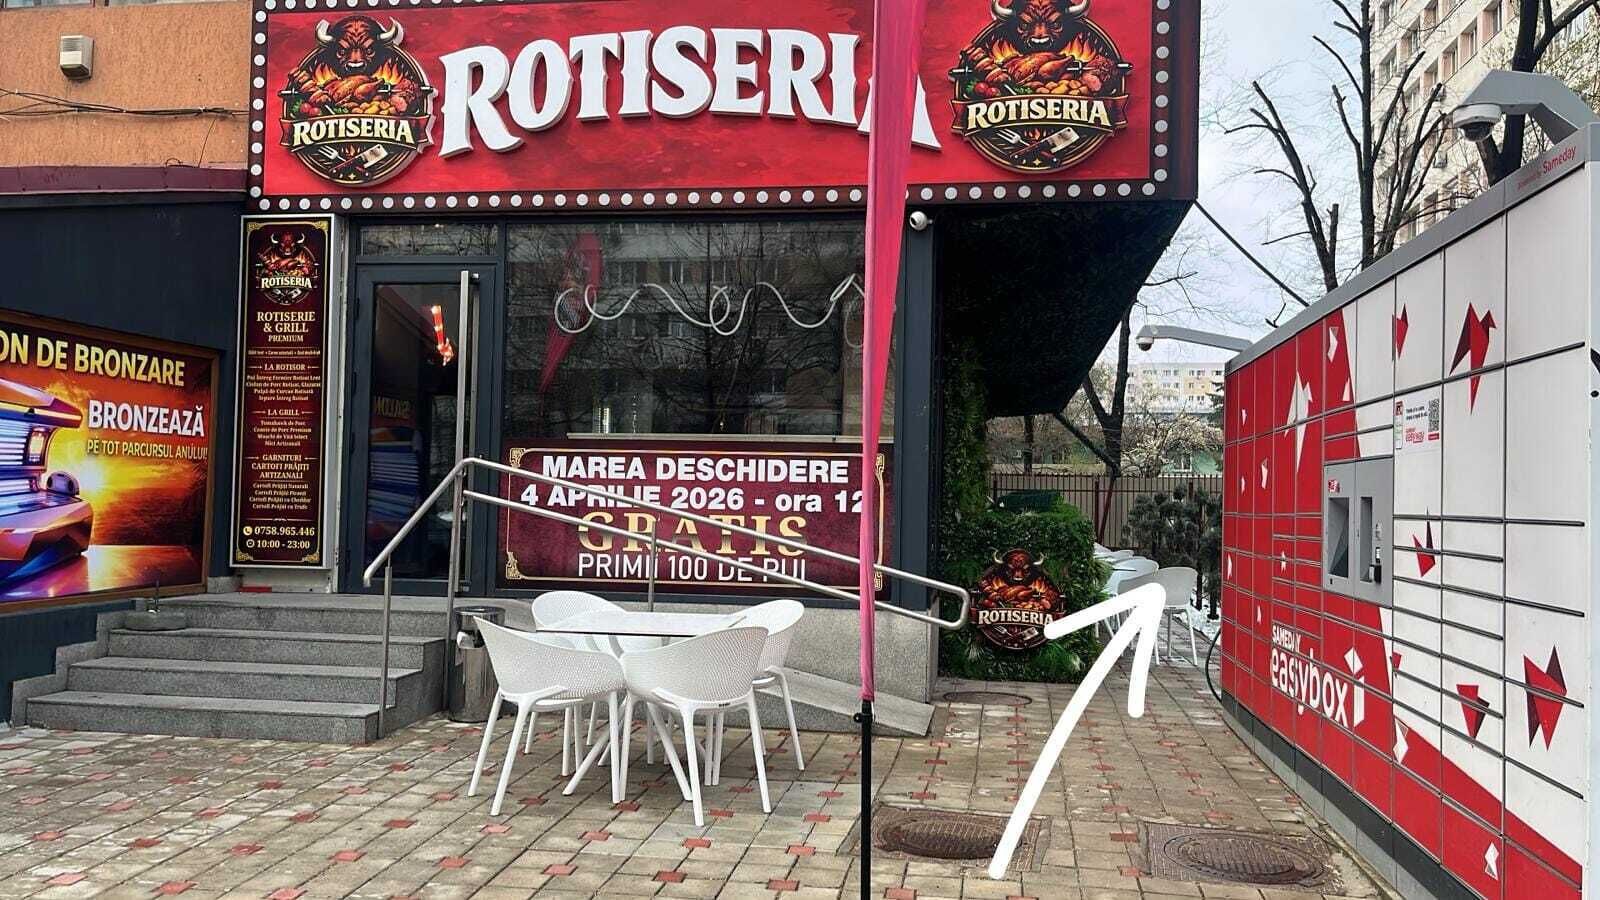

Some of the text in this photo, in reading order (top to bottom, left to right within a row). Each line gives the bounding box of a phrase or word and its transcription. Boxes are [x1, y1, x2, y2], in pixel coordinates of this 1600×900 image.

[966, 97, 1112, 131] ROTISERIA
[293, 117, 415, 147] ROTISERIA
[1542, 145, 1577, 174] Sameday
[260, 276, 313, 289] ROTISERIA
[256, 311, 316, 322] ROTISERIE
[263, 322, 309, 333] & GRILL
[268, 334, 304, 342] PREMIUM
[37, 336, 69, 371] DE
[75, 343, 185, 387] BRONZARE
[264, 363, 306, 371] LA ROTISOR
[88, 399, 205, 437] BRONZEAZĂ
[87, 438, 100, 454] PE
[101, 440, 120, 455] TOT
[121, 440, 174, 459] PARCURSUL
[262, 454, 302, 462] GARNITURI
[260, 471, 303, 479] ARTIZANALI
[542, 455, 849, 484] MAREA DESCHIDERE
[520, 484, 539, 507] 4
[547, 485, 662, 508] APRILIE
[670, 487, 745, 511] 2026
[754, 498, 765, 506] -
[774, 493, 823, 513] ora
[254, 526, 315, 537] 0758.965.446
[577, 511, 808, 557] GRATIS
[256, 540, 281, 549] 10:00
[287, 540, 311, 550] 23:00
[667, 554, 708, 581] 100
[718, 556, 753, 582] DE
[762, 557, 806, 583] PUI
[978, 609, 1055, 626] ROTISERIA
[1270, 647, 1348, 729] easybox
